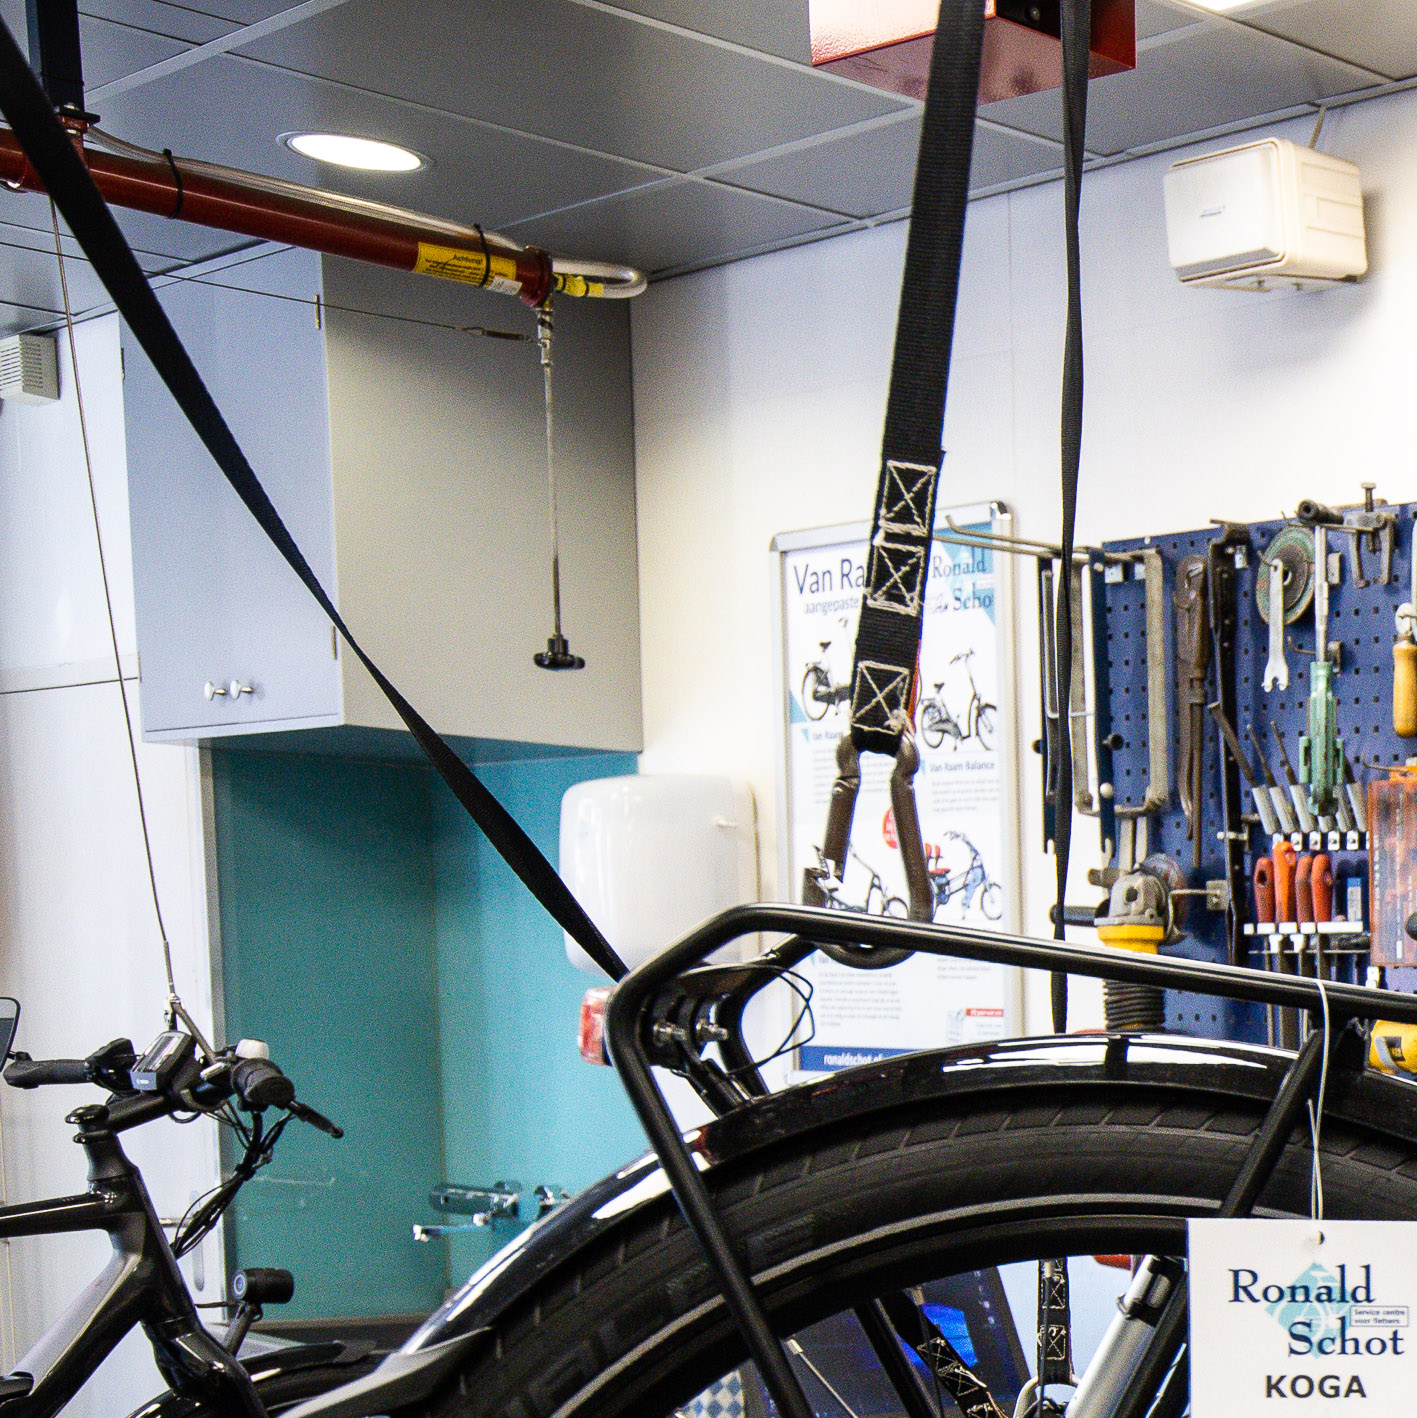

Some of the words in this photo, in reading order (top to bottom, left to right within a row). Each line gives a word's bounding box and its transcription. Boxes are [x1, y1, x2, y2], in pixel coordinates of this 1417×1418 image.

[794, 563, 832, 595] Van
[841, 558, 865, 591] Ra
[932, 547, 987, 578] Ronald
[952, 582, 994, 611] Scho
[1228, 1263, 1376, 1303] Ronald
[1354, 1308, 1381, 1316] Service
[1288, 1316, 1405, 1356] Schot
[1265, 1374, 1367, 1399] KOGA
